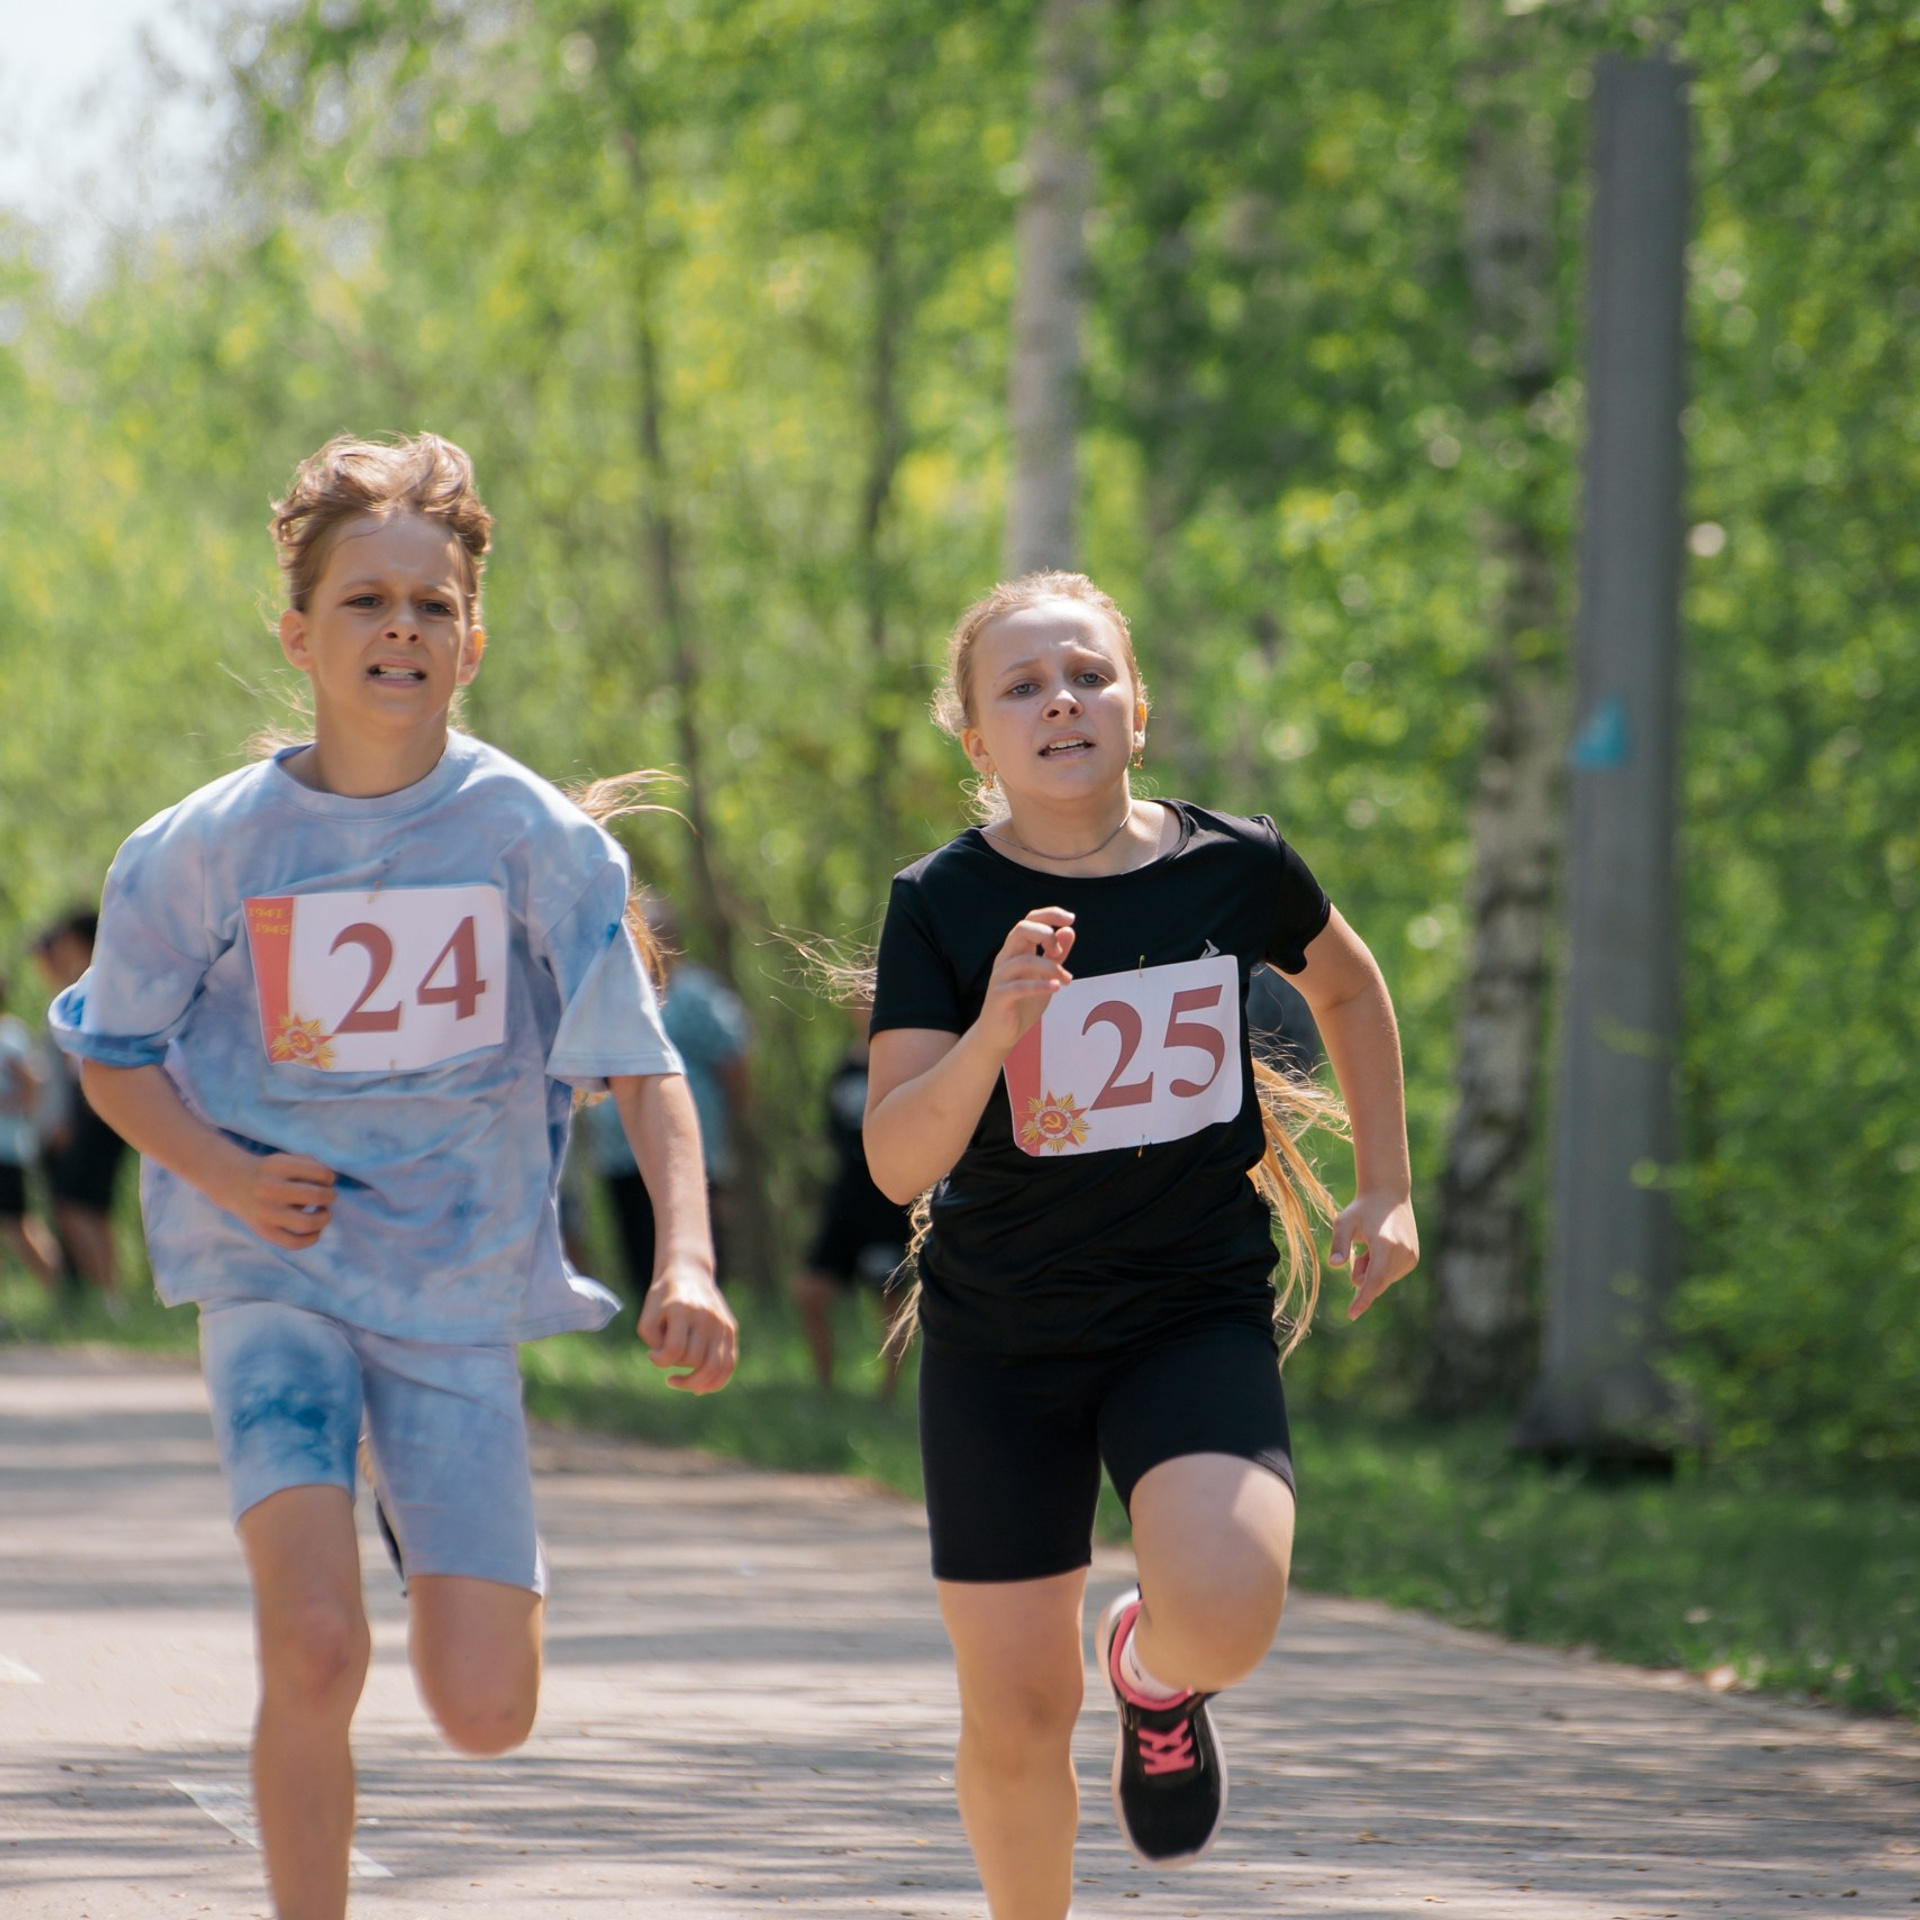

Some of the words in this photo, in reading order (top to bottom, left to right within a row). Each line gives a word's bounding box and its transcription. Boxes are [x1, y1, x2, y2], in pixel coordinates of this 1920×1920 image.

[255, 923, 290, 936] 1945
[328, 915, 487, 1034] 24
[1082, 984, 1226, 1111] 25
